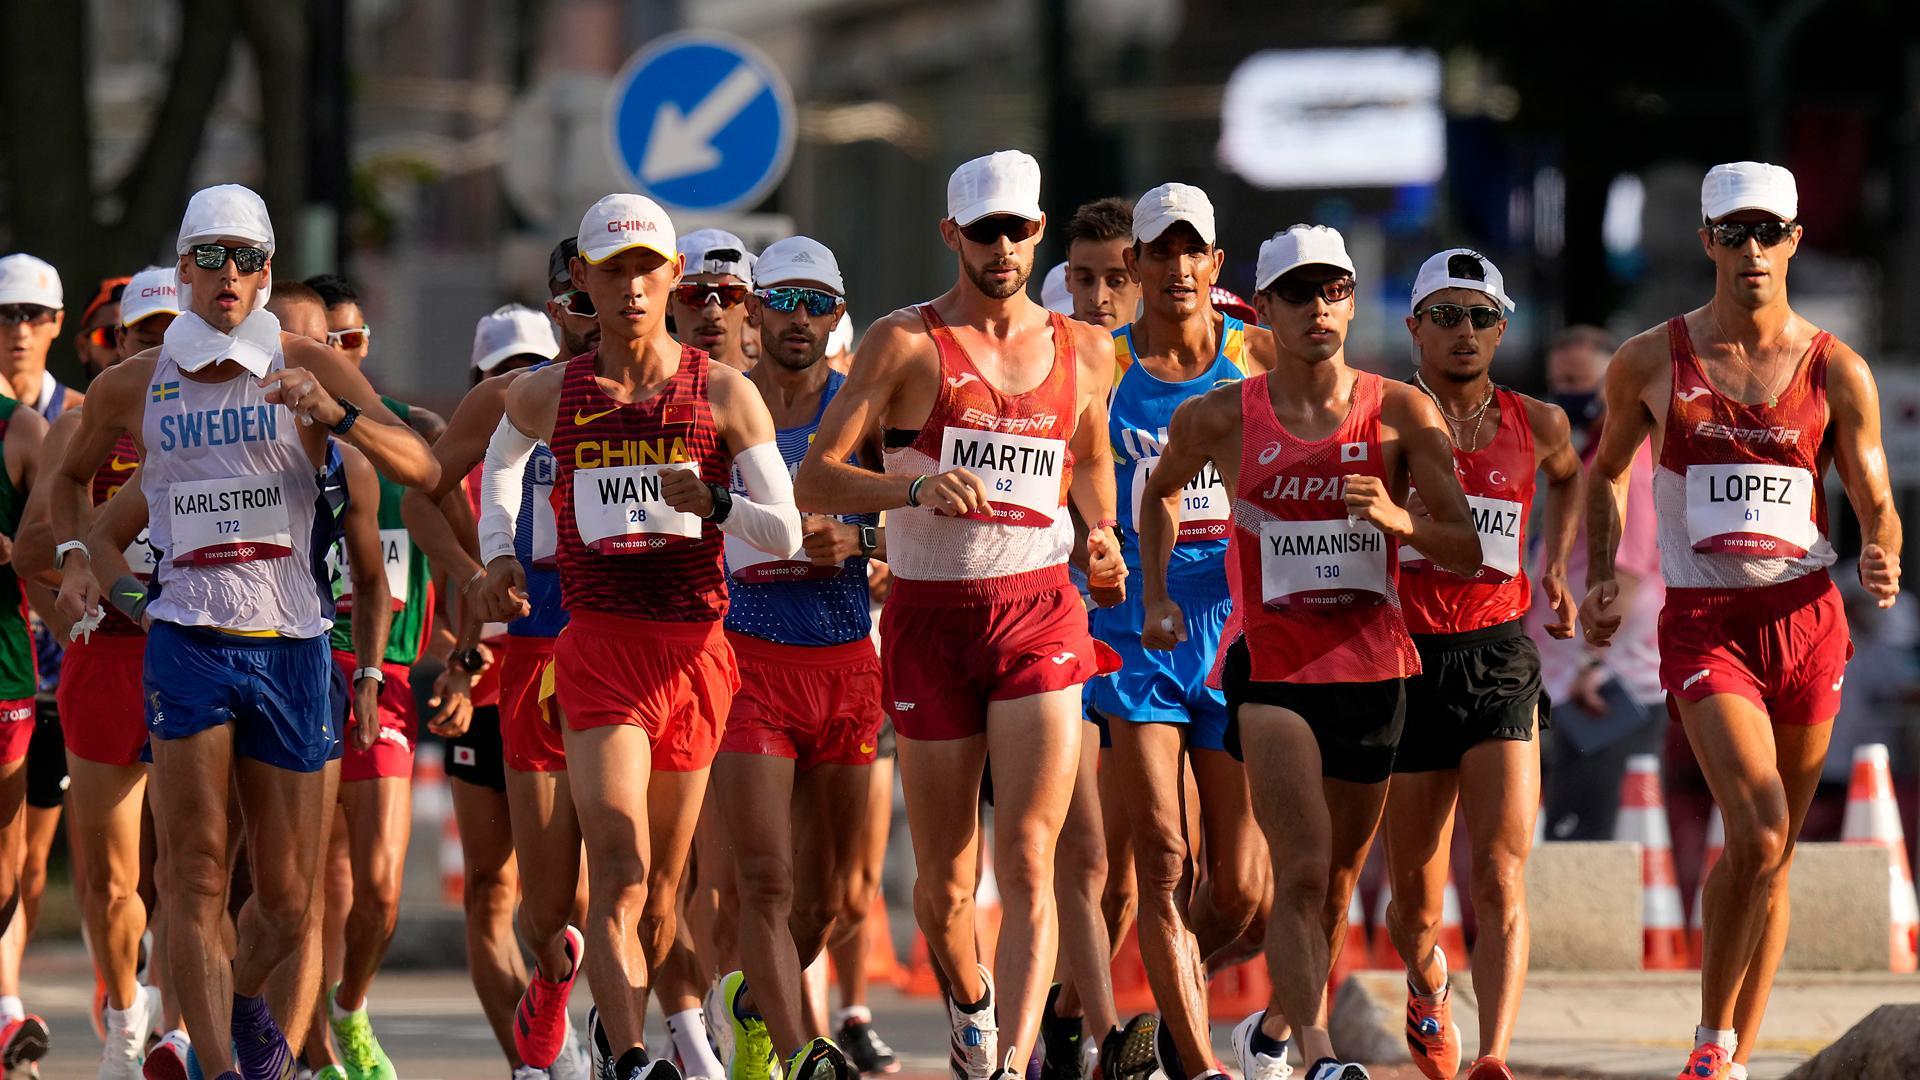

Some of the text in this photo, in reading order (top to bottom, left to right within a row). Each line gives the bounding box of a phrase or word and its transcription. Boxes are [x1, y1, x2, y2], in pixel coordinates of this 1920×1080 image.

[607, 220, 658, 233] CHINA
[141, 286, 178, 298] CHIN
[961, 407, 1058, 432] ESPAÑA
[160, 405, 277, 452] SWEDEN
[1695, 421, 1801, 445] ESPAÑA
[574, 436, 692, 470] CHINA
[952, 438, 1056, 477] MARTIN
[597, 475, 659, 505] WAN
[996, 478, 1013, 492] 62
[1709, 474, 1792, 505] LOPEZ
[174, 486, 282, 516] KARLSTROM
[1184, 496, 1210, 510] 102
[629, 509, 647, 523] 28
[993, 509, 1008, 517] 2020
[1744, 508, 1760, 522] 61
[216, 520, 240, 535] 172
[1191, 527, 1207, 535] 2020
[612, 540, 647, 549] TOKYO 2020
[1270, 532, 1381, 556] YAMANISHI
[1724, 539, 1759, 548] TOKYO 2020
[204, 552, 223, 560] TOKYO
[757, 567, 790, 577] TOKYO 2020
[1315, 565, 1340, 579] 130
